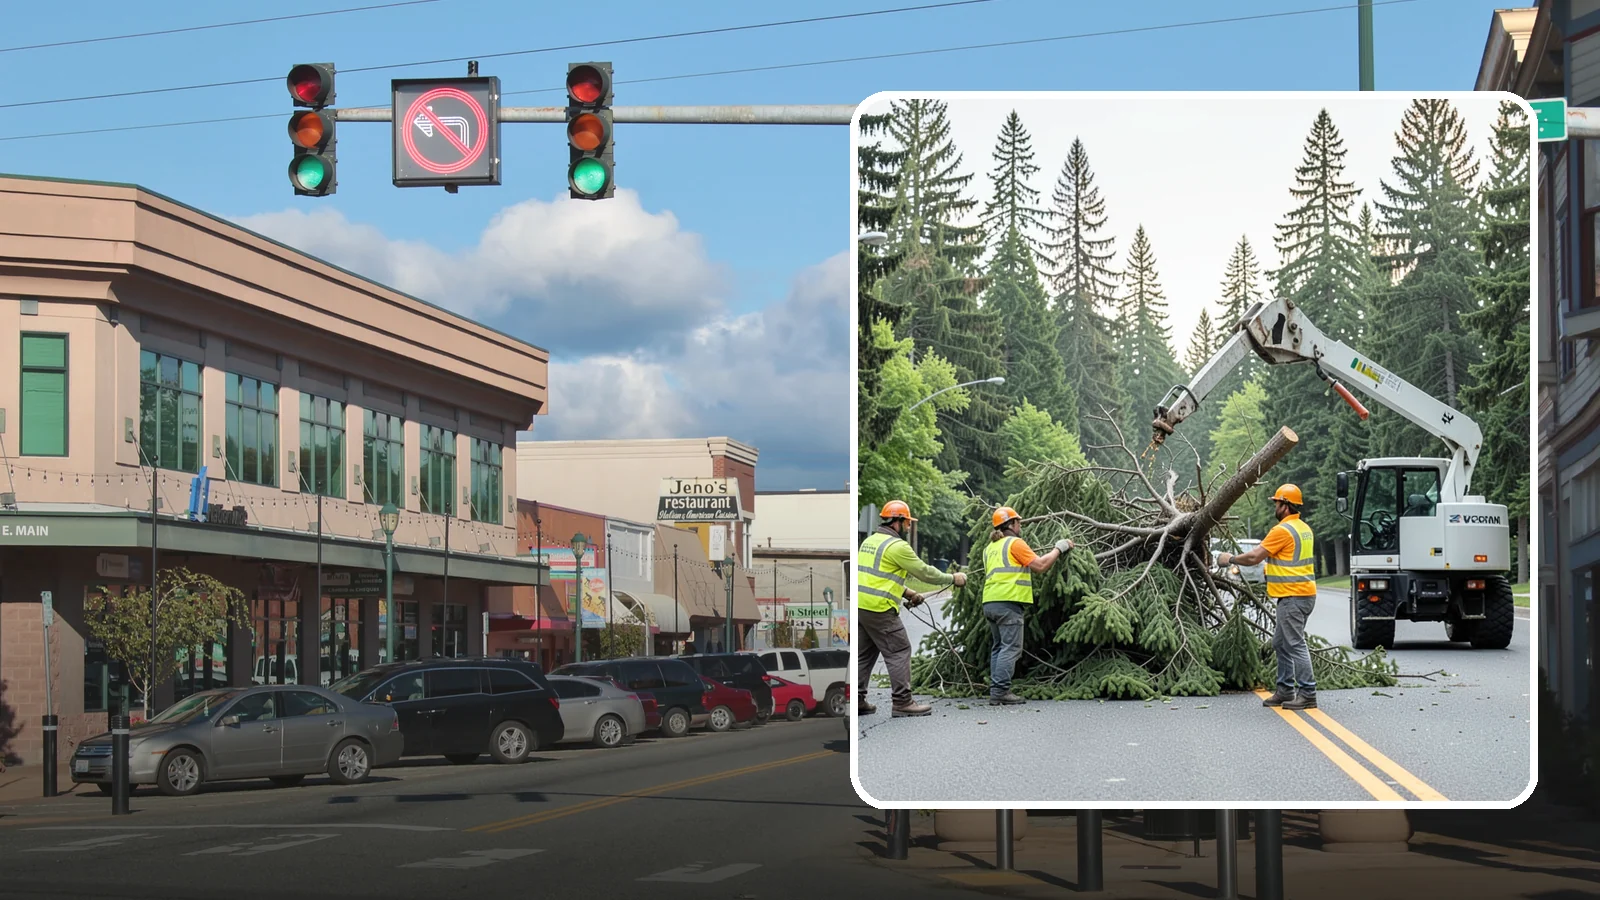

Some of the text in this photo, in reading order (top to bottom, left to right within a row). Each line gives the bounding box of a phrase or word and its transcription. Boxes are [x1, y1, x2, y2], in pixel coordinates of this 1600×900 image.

[669, 480, 727, 495] Jeno's
[665, 496, 731, 509] restaurant
[658, 509, 681, 520] Italian
[686, 509, 715, 519] American
[715, 509, 737, 519] Cuisine
[2, 525, 49, 536] E. MAIN
[797, 608, 828, 617] Street
[791, 619, 824, 627] lass
